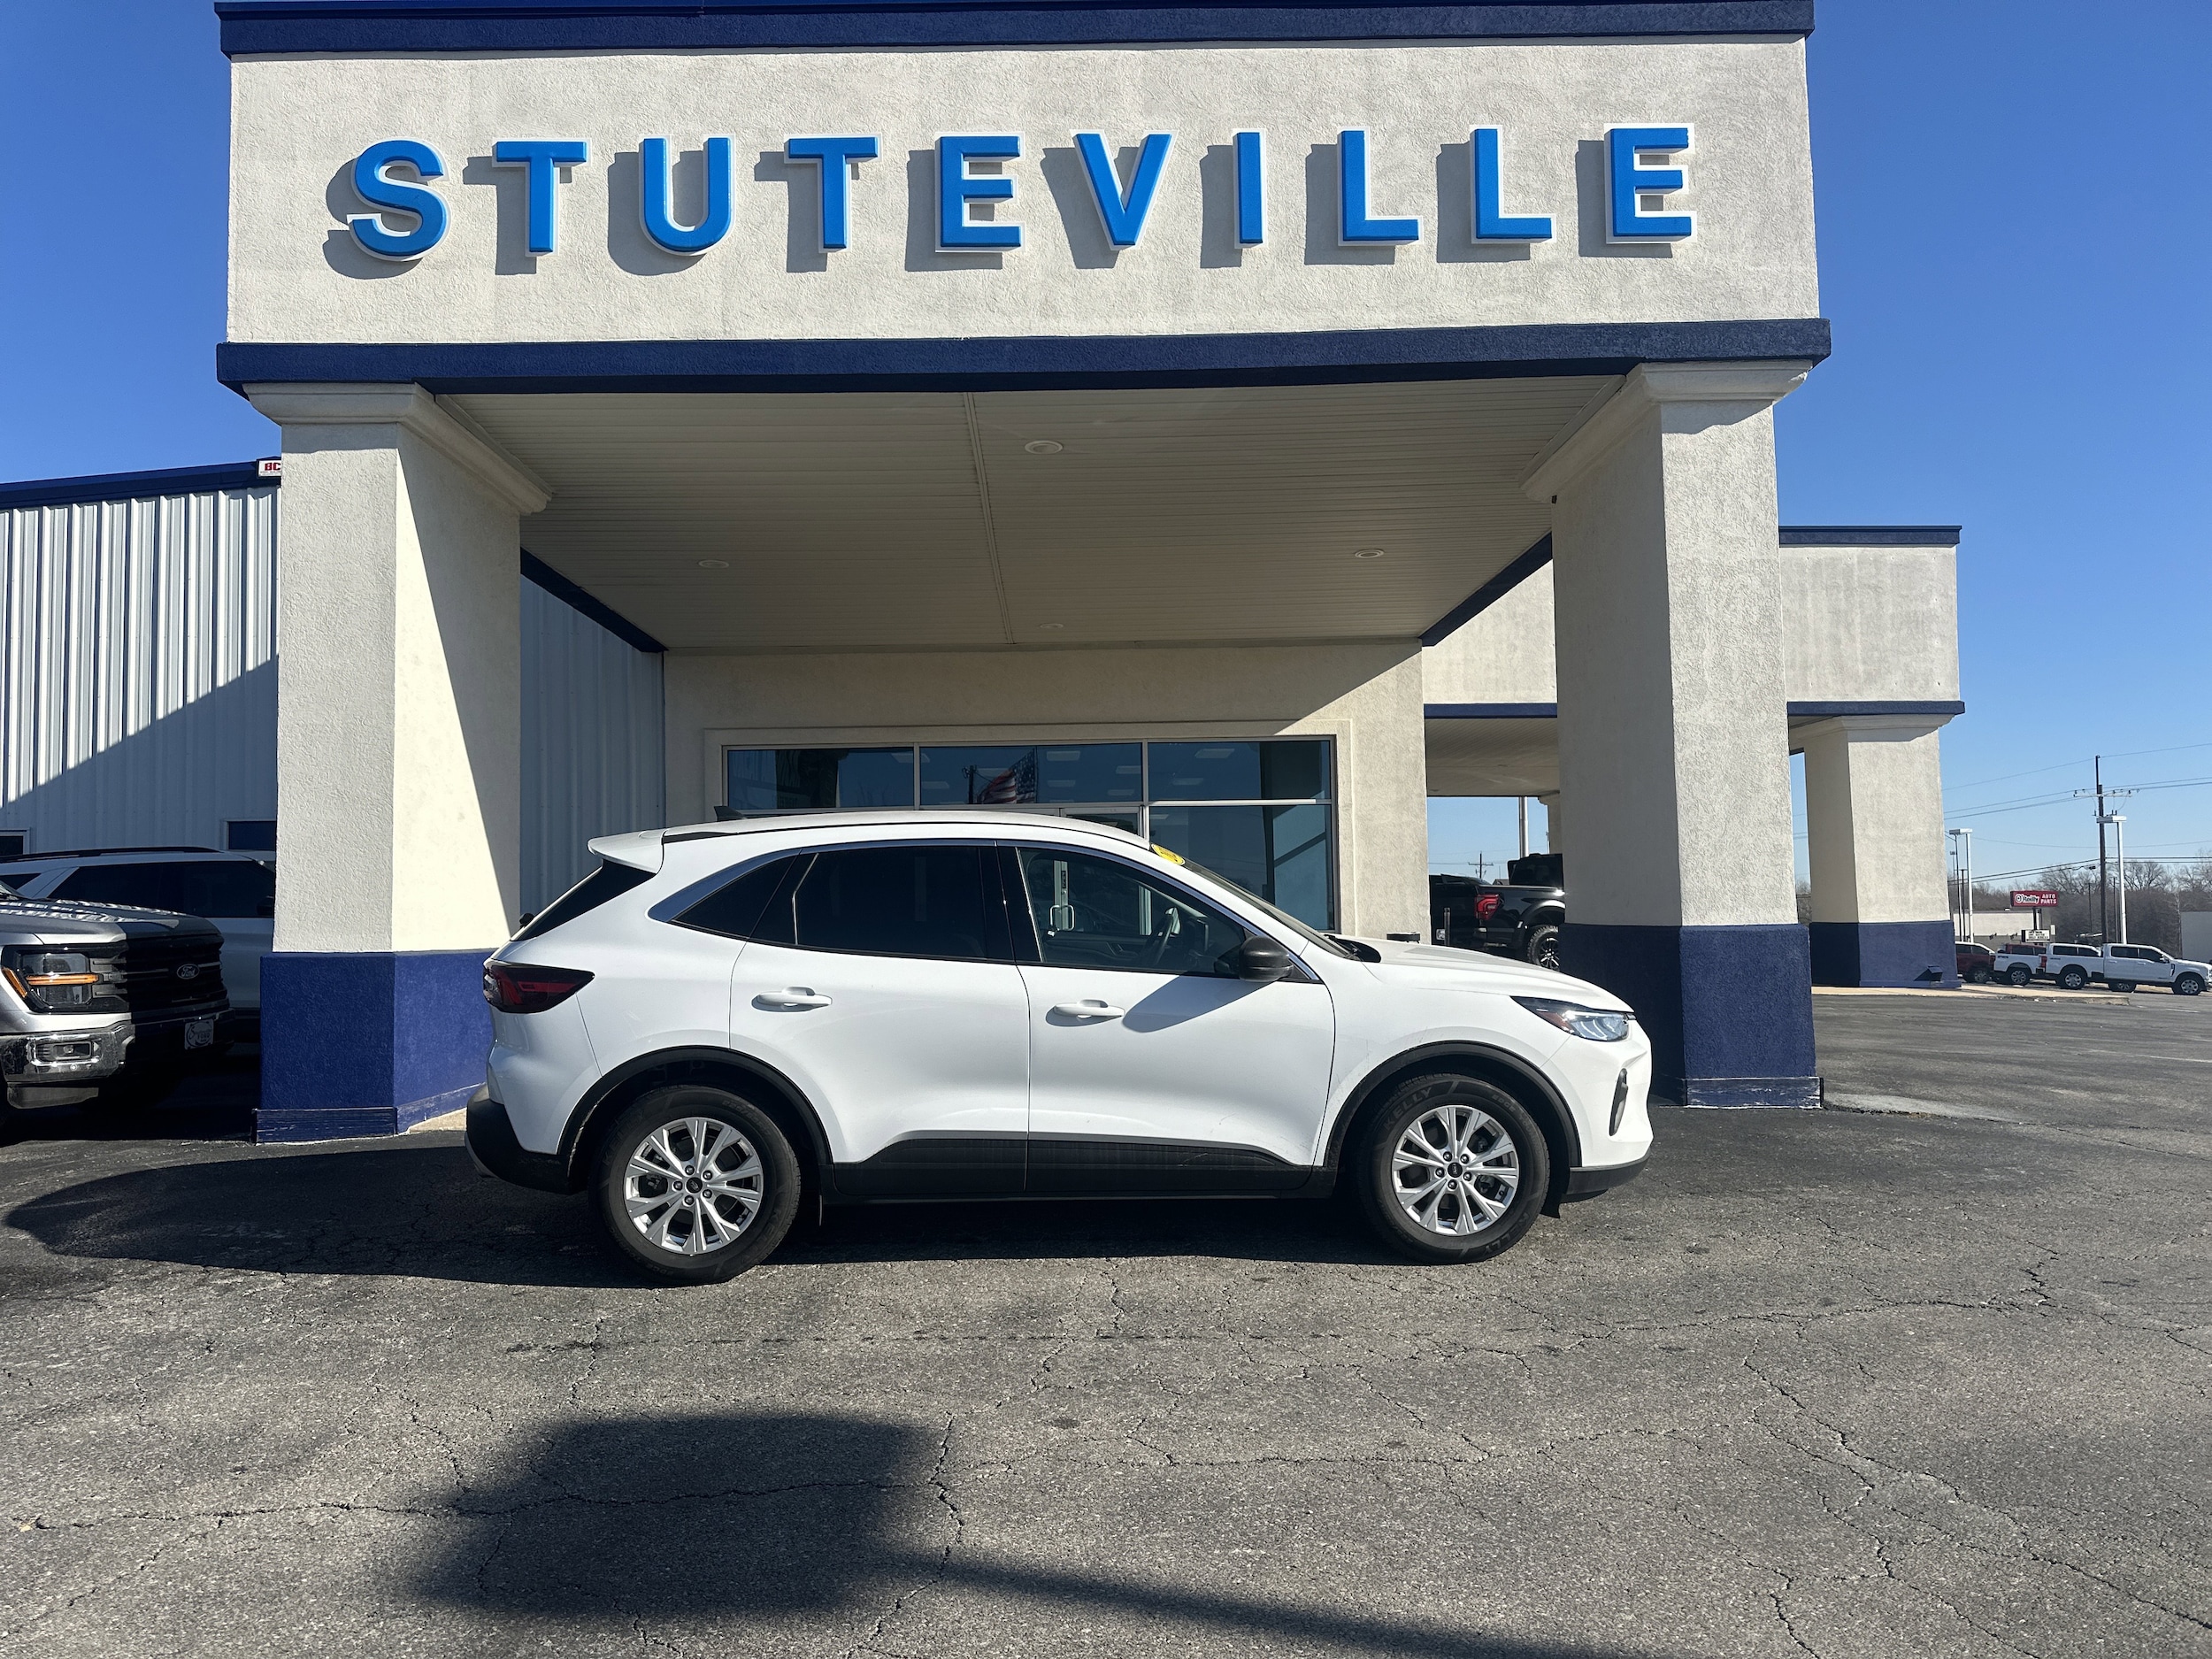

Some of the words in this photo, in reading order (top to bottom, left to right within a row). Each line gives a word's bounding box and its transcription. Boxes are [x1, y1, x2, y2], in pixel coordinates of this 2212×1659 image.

[348, 125, 1694, 258] STUTEVILLE
[1382, 1087, 1432, 1131] KELLY
[1483, 1210, 1531, 1255] KELLY
